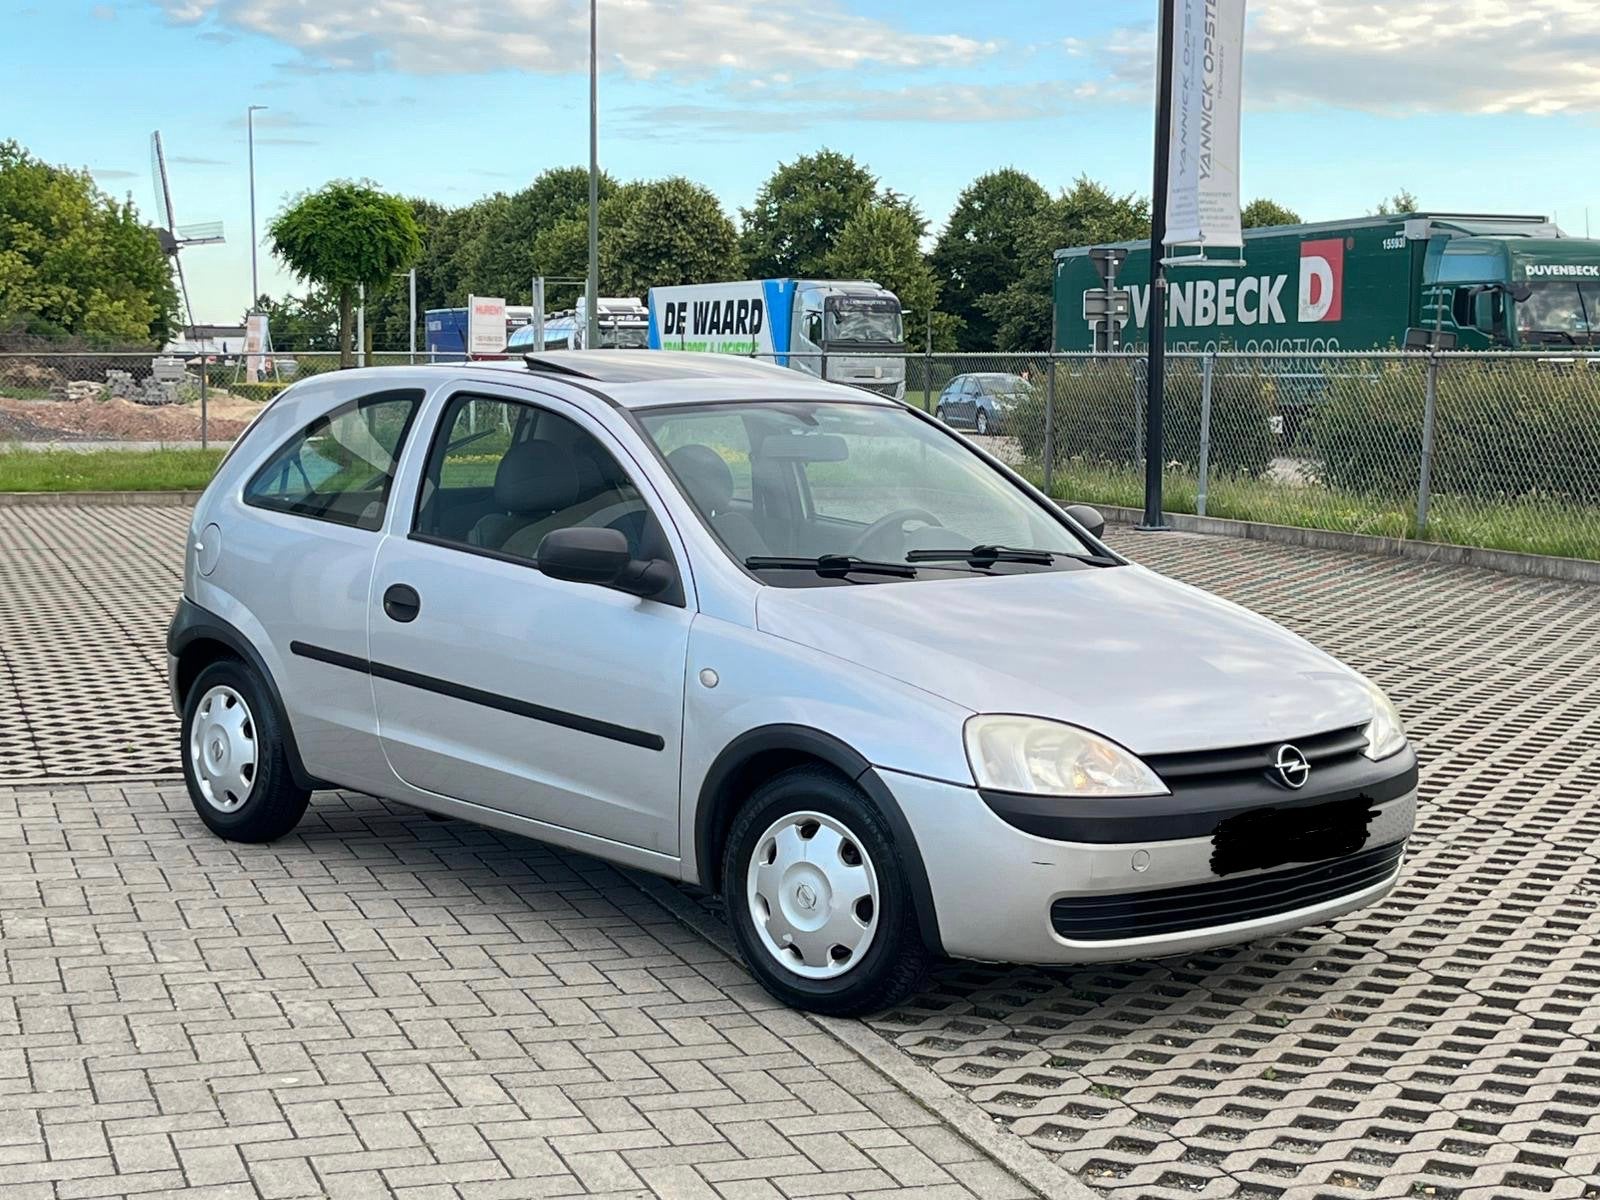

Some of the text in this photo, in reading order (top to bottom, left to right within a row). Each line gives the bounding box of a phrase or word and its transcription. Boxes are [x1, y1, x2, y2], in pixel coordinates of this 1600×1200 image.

[1179, 74, 1190, 176] YANNICK
[1199, 80, 1214, 180] YANNICK
[1298, 256, 1334, 322] D
[1525, 264, 1600, 276] DUVENBECK
[664, 298, 763, 335] DE WAARD
[1088, 274, 1289, 330] VNBECK
